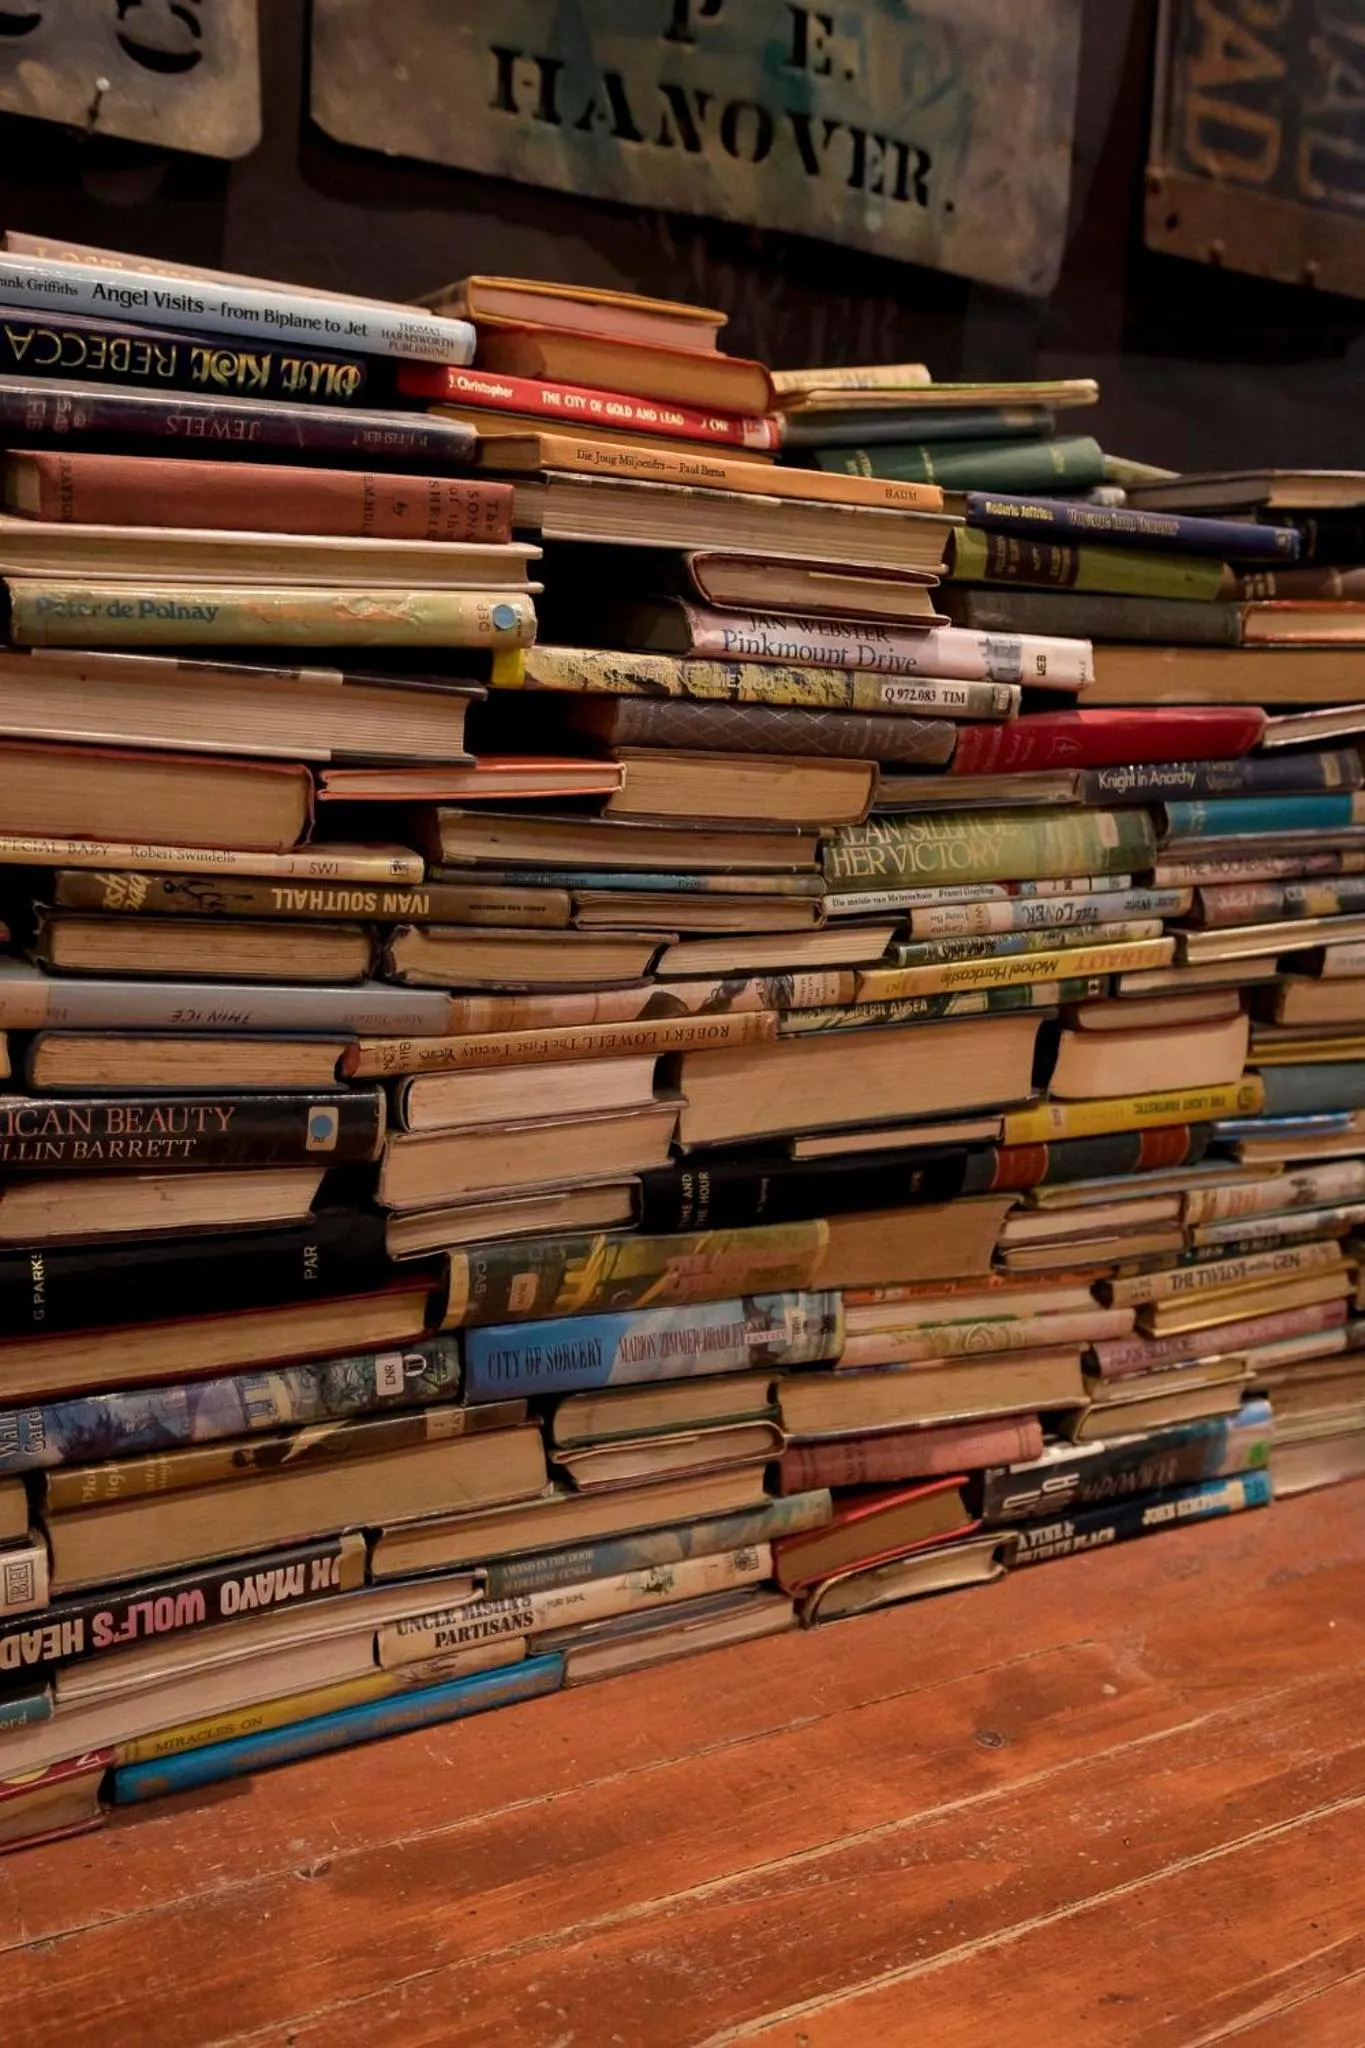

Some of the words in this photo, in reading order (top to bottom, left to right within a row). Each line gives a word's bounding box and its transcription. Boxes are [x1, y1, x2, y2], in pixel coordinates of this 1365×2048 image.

[489, 44, 953, 212] HANOVER.
[27, 279, 79, 297] Griffiths
[92, 283, 149, 309] Angel
[153, 291, 205, 314] Visits
[221, 302, 259, 321] from
[264, 308, 322, 330] Biplane
[325, 318, 341, 333] to
[344, 320, 369, 337] Jet
[4, 325, 177, 378] REBECCA
[382, 329, 454, 350] HARMSWORTH
[389, 340, 451, 358] PUBLISHING
[458, 378, 515, 401] Christopher
[542, 389, 560, 407] THE
[564, 393, 588, 411] CITY
[590, 398, 602, 413] OF
[605, 400, 634, 419] GOLD
[636, 406, 658, 424] AND
[660, 409, 686, 428] LEAD
[165, 415, 261, 441] JEWELS
[576, 447, 593, 461] Die
[679, 462, 700, 477] Paul
[884, 487, 919, 502] HAUM
[393, 502, 408, 518] by
[35, 595, 102, 620] Peter
[106, 598, 133, 619] de
[138, 600, 220, 625] Polnay
[748, 614, 788, 634] JAN
[794, 614, 893, 645] WEBSTER
[721, 629, 849, 666] Pinkmount
[855, 643, 918, 673] Drive
[1037, 654, 1048, 677] WEB
[884, 688, 894, 702] Q
[896, 689, 937, 704] 972.083
[941, 690, 967, 706] TIM
[1099, 772, 1136, 794] Knight
[1137, 771, 1149, 787] in
[1151, 769, 1198, 790] Anarchy
[67, 842, 111, 857] BABY
[130, 844, 173, 860] Robert
[175, 847, 237, 864] Swindells
[832, 845, 888, 878] HER
[888, 838, 1003, 876] VICTORY
[287, 861, 295, 875] J
[309, 862, 340, 876] SWI
[271, 887, 378, 914] SOUTHALL
[382, 893, 430, 915] IVAN
[1021, 903, 1075, 926] LONER
[940, 965, 1007, 987] Hardcastle
[1007, 957, 1060, 981] Michael
[168, 1008, 201, 1023] ICE
[207, 1009, 253, 1025] THIN
[551, 1037, 577, 1054] The
[584, 1029, 657, 1050] LOWELL
[661, 1023, 731, 1044] ROBERT
[417, 1046, 457, 1063] Years
[460, 1042, 514, 1061] Twenty
[518, 1040, 548, 1056] First
[0, 1107, 94, 1140] ICAN
[106, 1105, 237, 1134] BEAUTY
[0, 1140, 66, 1163] LLIN
[74, 1137, 198, 1161] BARRETT
[681, 1173, 692, 1193] AND
[697, 1170, 710, 1199] HOUR
[678, 1198, 692, 1230] TIME
[303, 1244, 318, 1281] PAR
[617, 1335, 658, 1364] MARION
[657, 1328, 702, 1358] ZIMMER
[487, 1355, 521, 1381] CITY
[525, 1352, 544, 1376] OF
[546, 1337, 604, 1373] SORCERY
[384, 1363, 396, 1387] ENR
[219, 1563, 305, 1616] MAYO
[92, 1588, 207, 1648] WOLF'S
[394, 1608, 457, 1636] UNCLE
[433, 1611, 534, 1649] PARTISANS
[0, 1617, 85, 1671] HEAD
[154, 1721, 236, 1753] MIRACLES
[240, 1715, 264, 1731] ON
